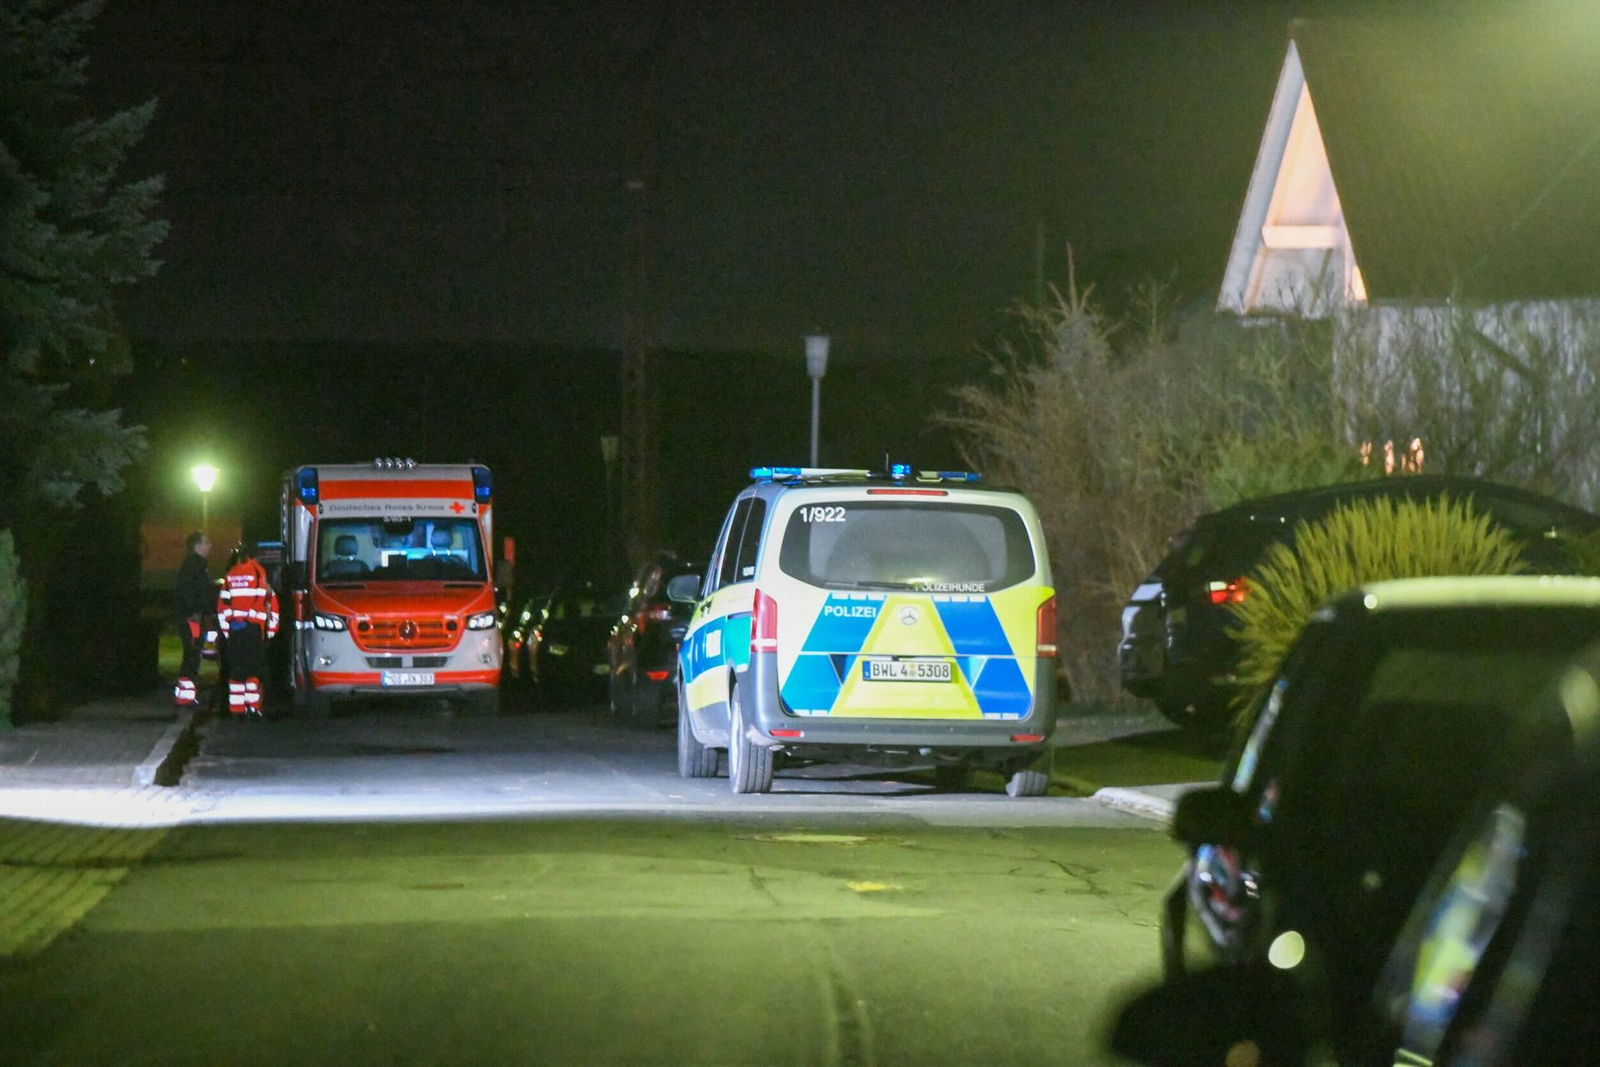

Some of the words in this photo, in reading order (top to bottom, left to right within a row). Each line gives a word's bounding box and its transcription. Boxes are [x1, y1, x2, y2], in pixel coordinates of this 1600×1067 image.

[799, 506, 846, 523] 1/922
[824, 604, 877, 618] POLIZEI
[872, 663, 897, 677] BWL
[918, 664, 950, 678] 5308
